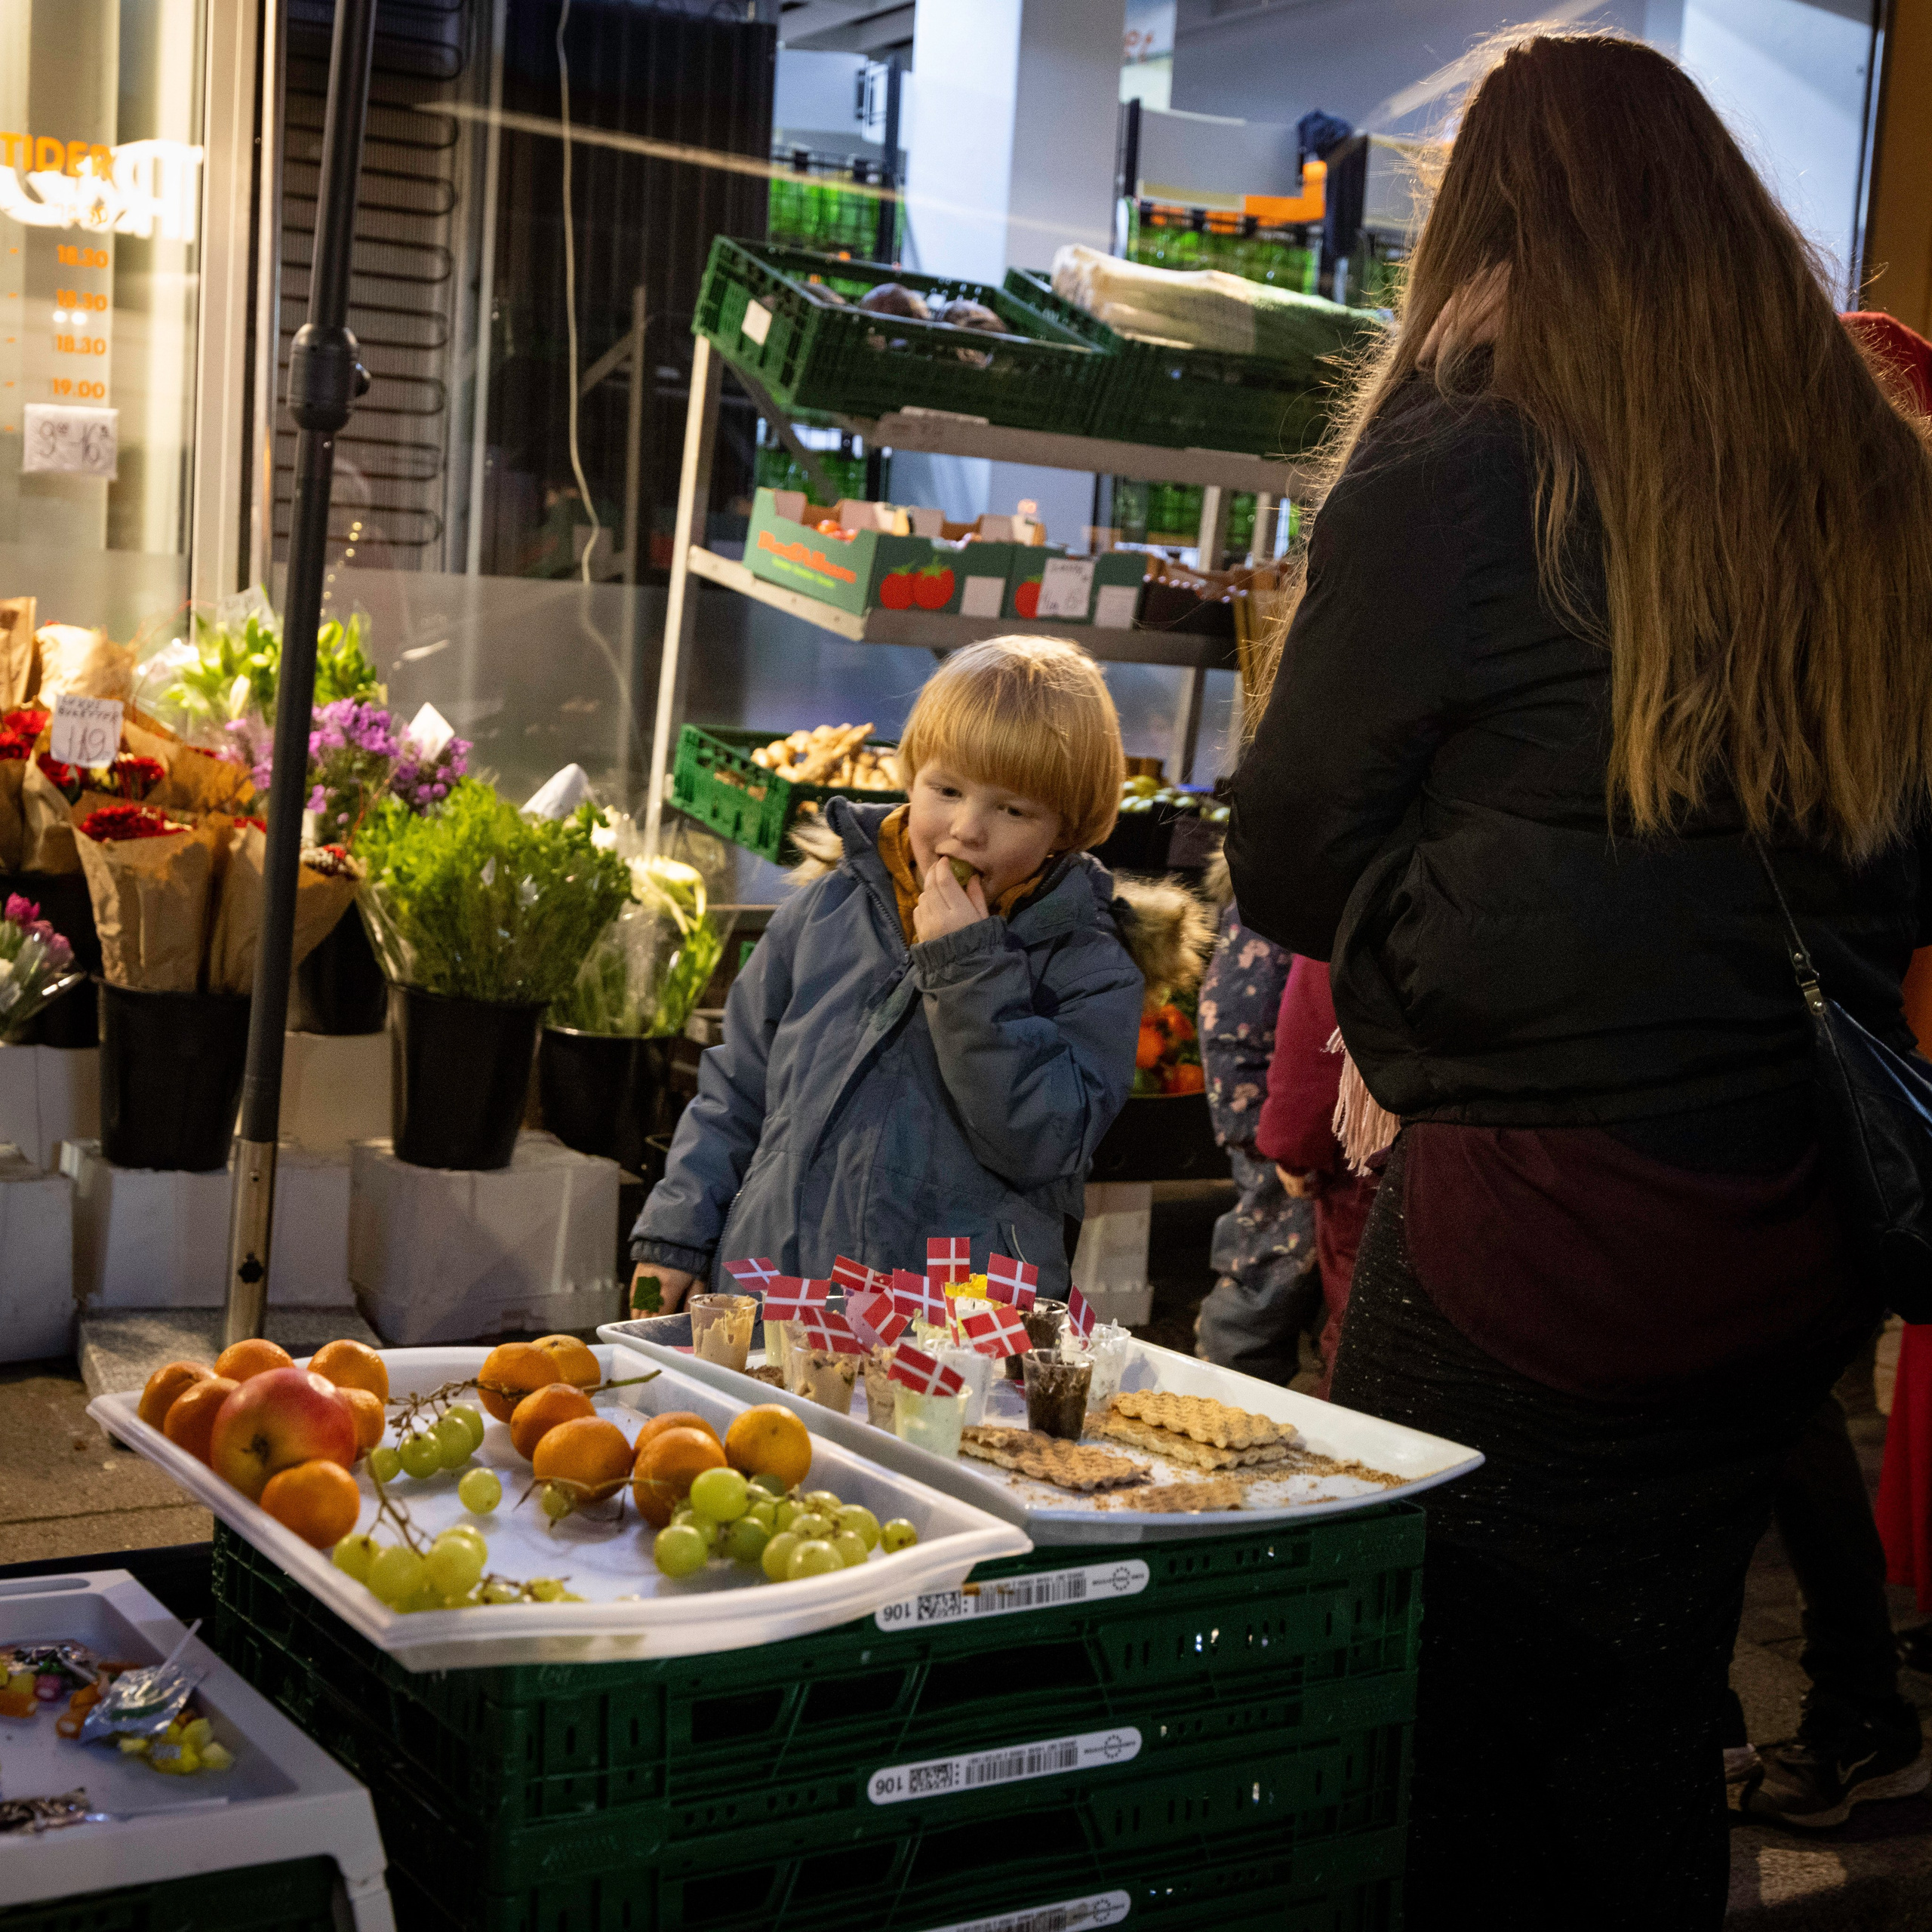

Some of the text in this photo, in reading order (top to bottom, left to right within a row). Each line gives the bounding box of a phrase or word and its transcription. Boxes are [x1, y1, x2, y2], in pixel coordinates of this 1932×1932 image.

[57, 244, 109, 269] 18.30
[53, 377, 106, 399] 19.00
[884, 1602, 911, 1622] 106
[875, 1776, 903, 1796] 106
